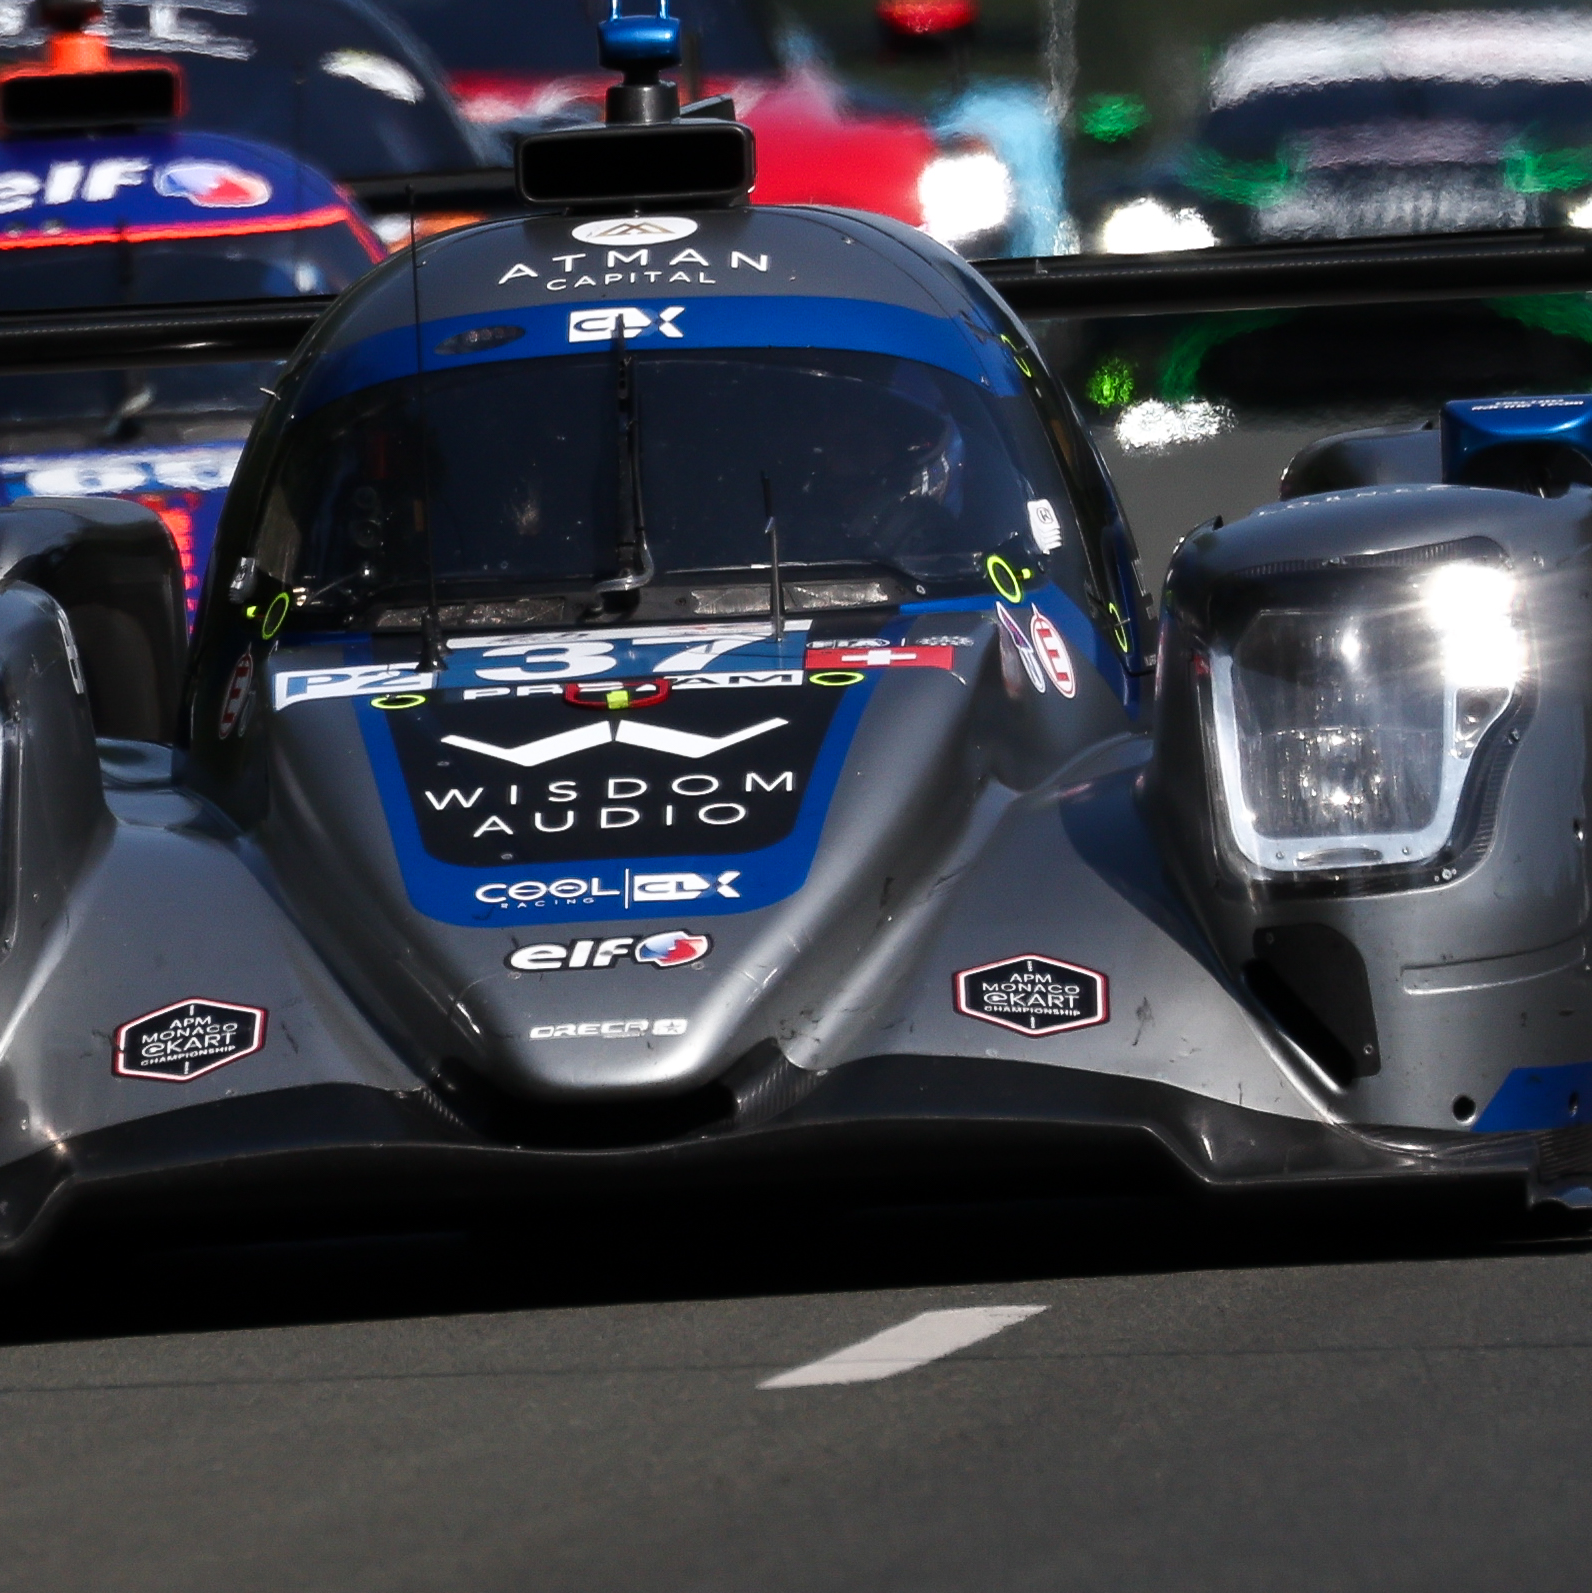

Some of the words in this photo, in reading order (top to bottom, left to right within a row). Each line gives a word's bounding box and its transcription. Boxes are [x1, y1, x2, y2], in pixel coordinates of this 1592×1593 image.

[498, 248, 769, 285] ATMAN
[546, 271, 716, 291] CAPITAL
[475, 634, 775, 681] 37
[287, 668, 426, 697] P2
[425, 771, 793, 810] WISDOM
[473, 803, 746, 838] AUDIO
[475, 877, 620, 903] COOL
[633, 870, 741, 902] CLX
[501, 897, 595, 908] RACING
[510, 937, 634, 970] elf
[1010, 973, 1052, 983] APM
[982, 983, 1080, 995] MONACO
[984, 1006, 1081, 1016] CHAMPIONSHIP
[169, 1016, 212, 1029] APM
[142, 1023, 238, 1044] MONACO
[140, 1045, 236, 1066] CHAMPIONSHIP
